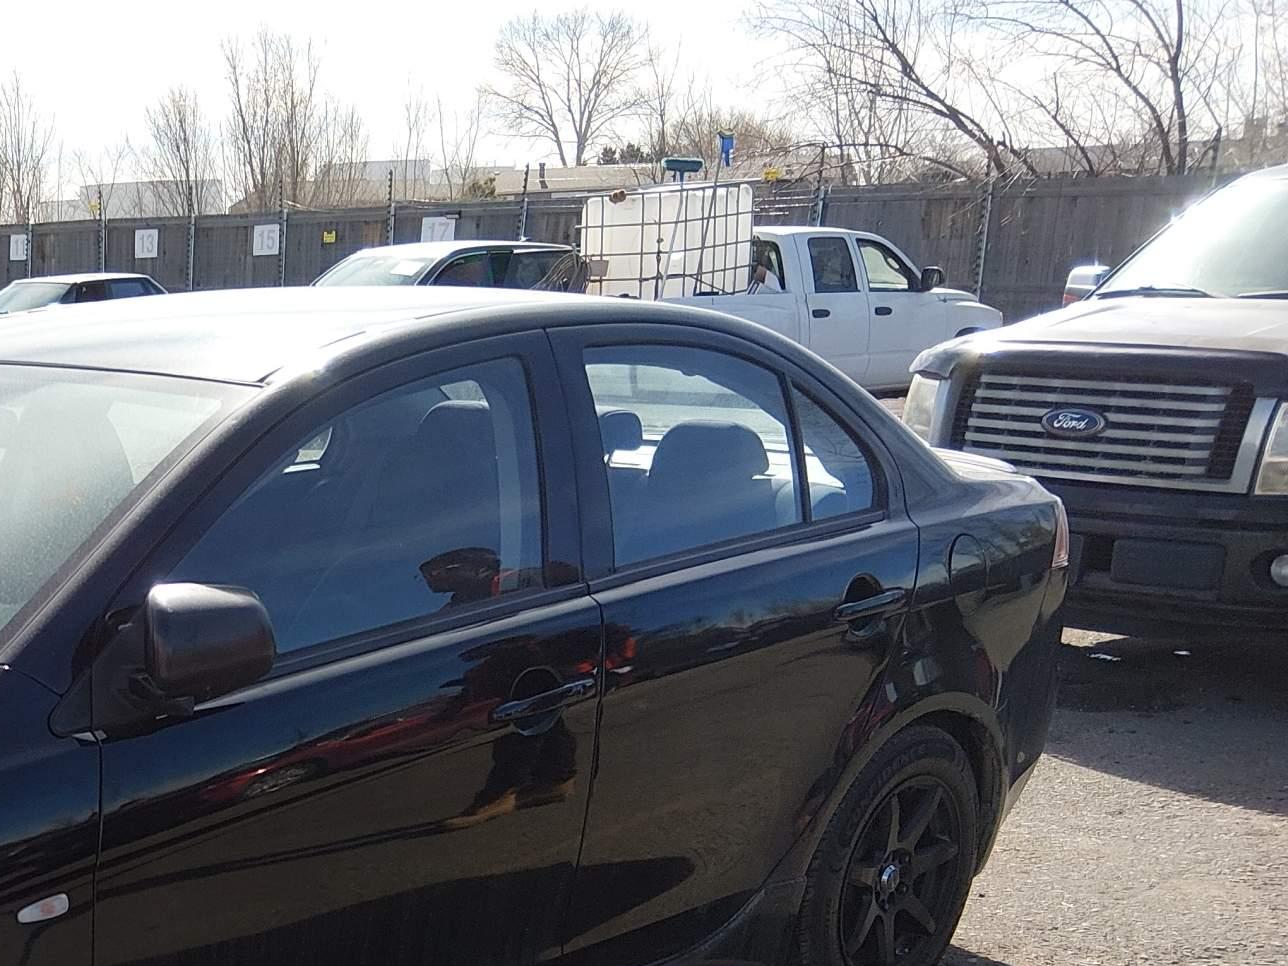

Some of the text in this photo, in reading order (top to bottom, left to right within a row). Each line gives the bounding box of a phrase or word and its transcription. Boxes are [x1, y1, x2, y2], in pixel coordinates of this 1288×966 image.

[139, 233, 154, 253] 13
[258, 229, 275, 250] 15
[1053, 412, 1089, 430] Ford
